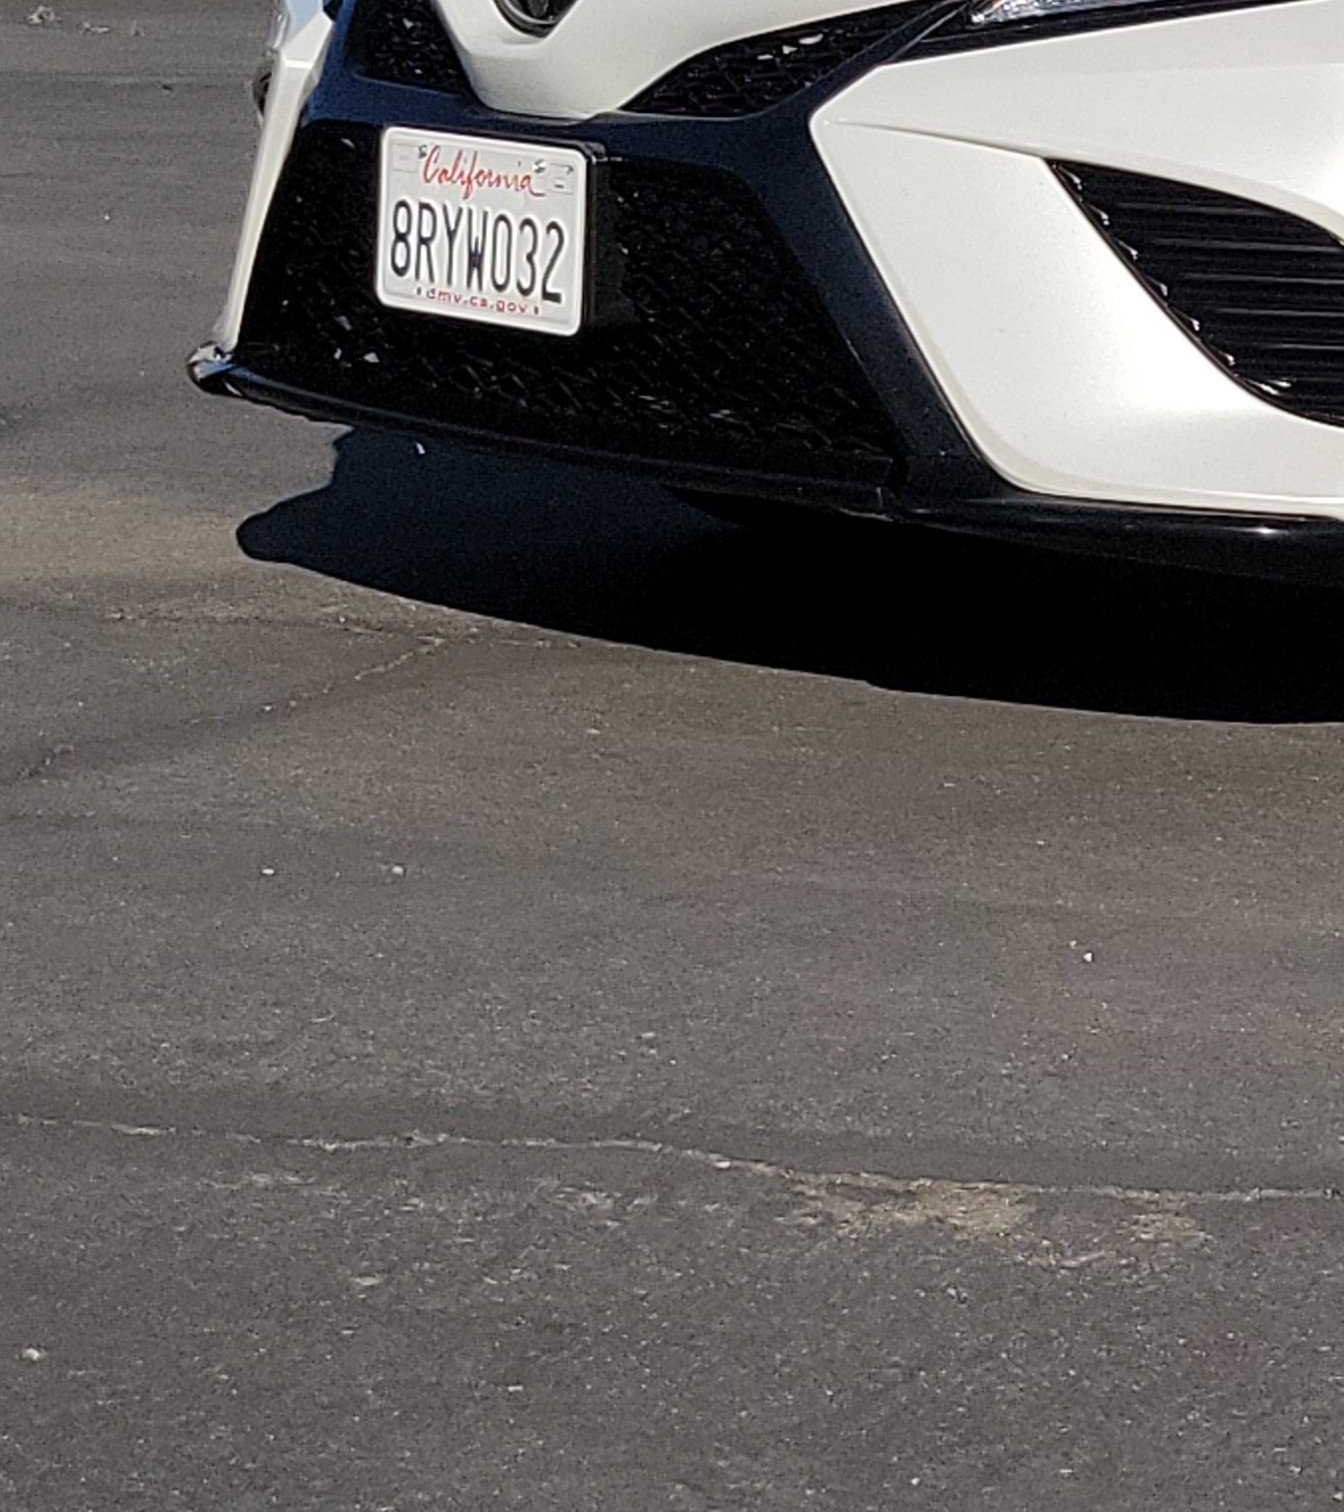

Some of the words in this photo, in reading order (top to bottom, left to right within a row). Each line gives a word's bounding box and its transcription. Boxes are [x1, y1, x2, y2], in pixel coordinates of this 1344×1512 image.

[422, 144, 547, 200] California
[390, 199, 565, 304] 8RYW032
[425, 287, 528, 314] dmv.ca.gov
